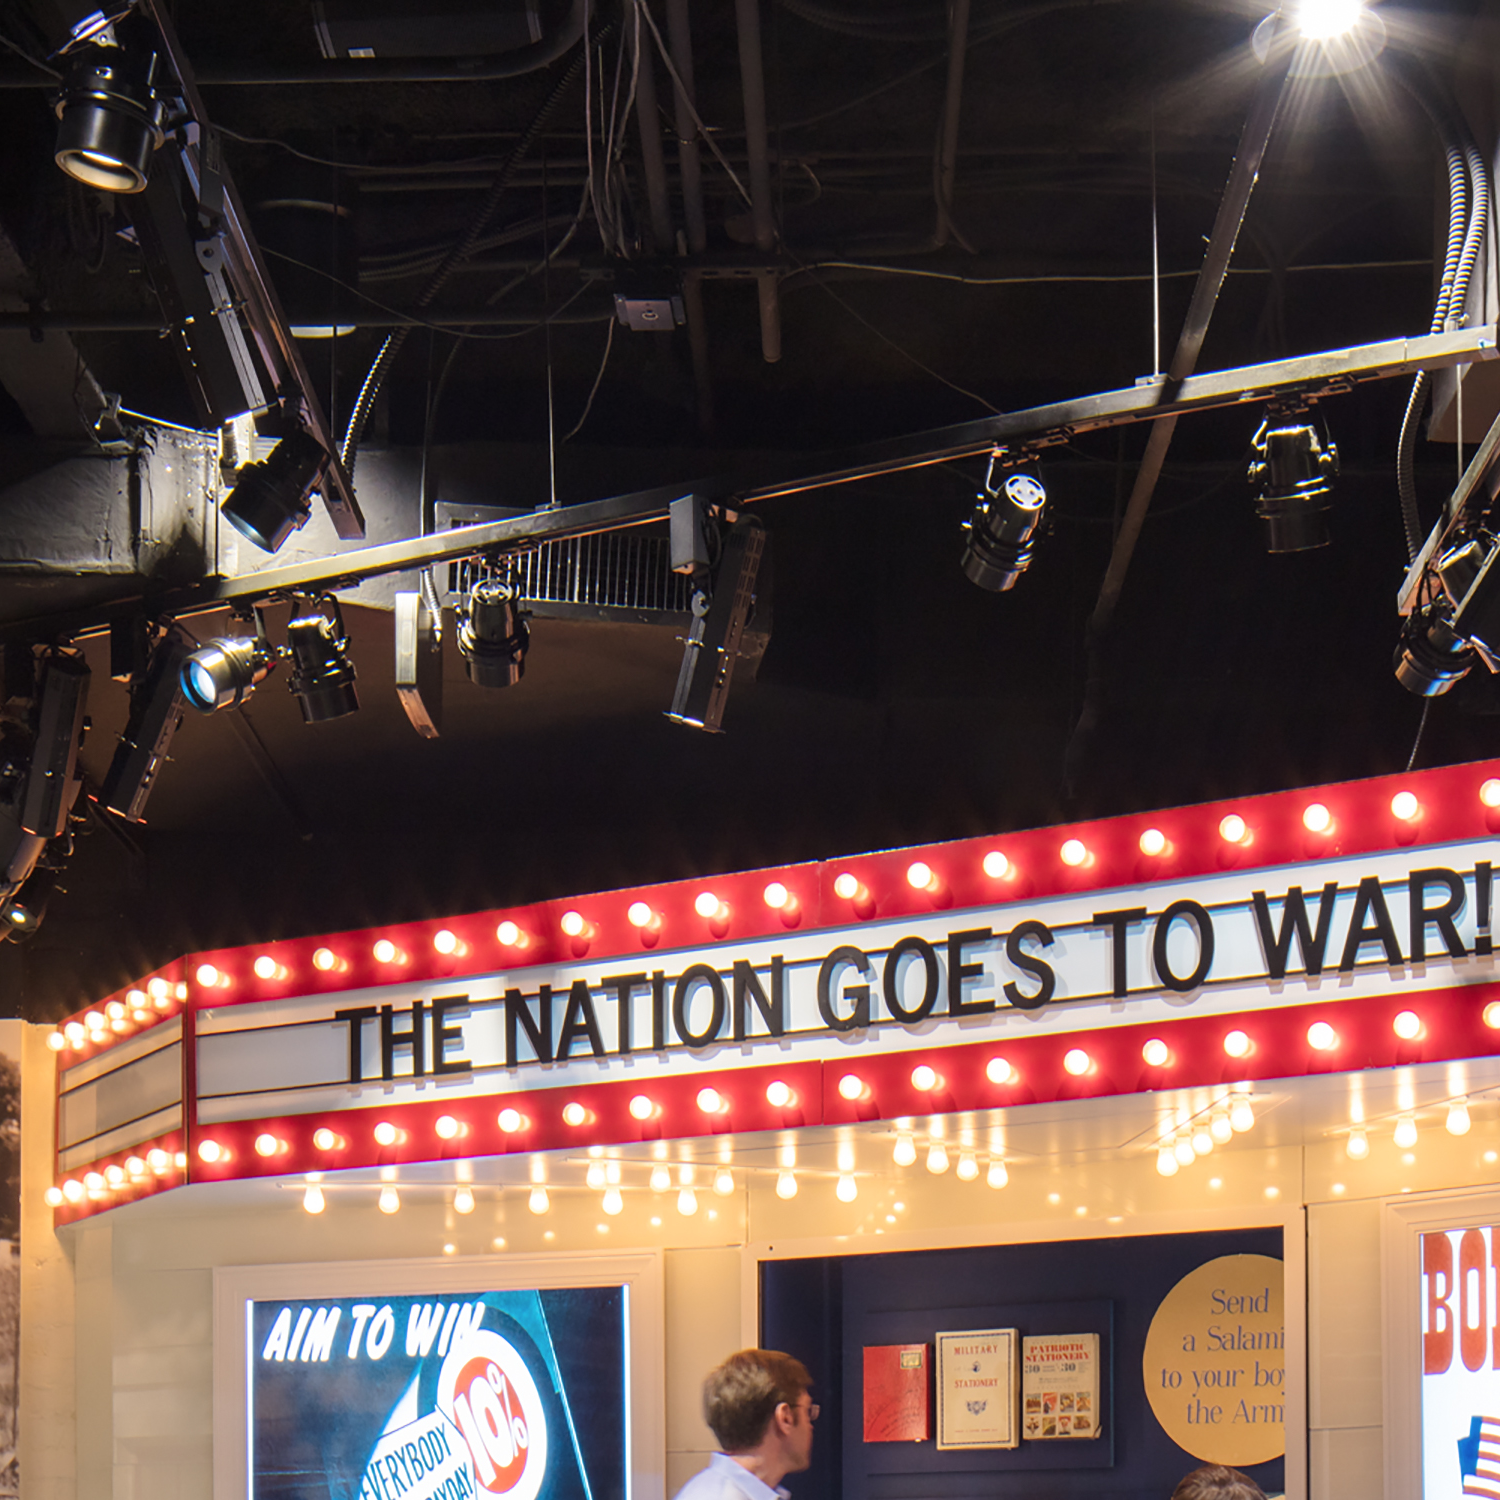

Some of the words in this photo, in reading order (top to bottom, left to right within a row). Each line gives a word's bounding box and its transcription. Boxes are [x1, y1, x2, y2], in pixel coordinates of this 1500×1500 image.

[334, 996, 474, 1084] THE
[502, 954, 787, 1067] NATION
[817, 919, 1057, 1032] GOES
[1094, 899, 1215, 998] TO
[1250, 860, 1496, 978] WAR!
[1211, 1288, 1270, 1315] Send
[263, 1307, 342, 1362] AIM
[348, 1304, 396, 1361] TO
[405, 1301, 486, 1357] WIN
[1183, 1334, 1196, 1352] a
[954, 1344, 998, 1356] MILITARY
[1161, 1366, 1182, 1389] to
[1192, 1368, 1245, 1397] your
[453, 1361, 529, 1487] 10%
[1186, 1398, 1223, 1425] the
[1231, 1399, 1285, 1425] Arm
